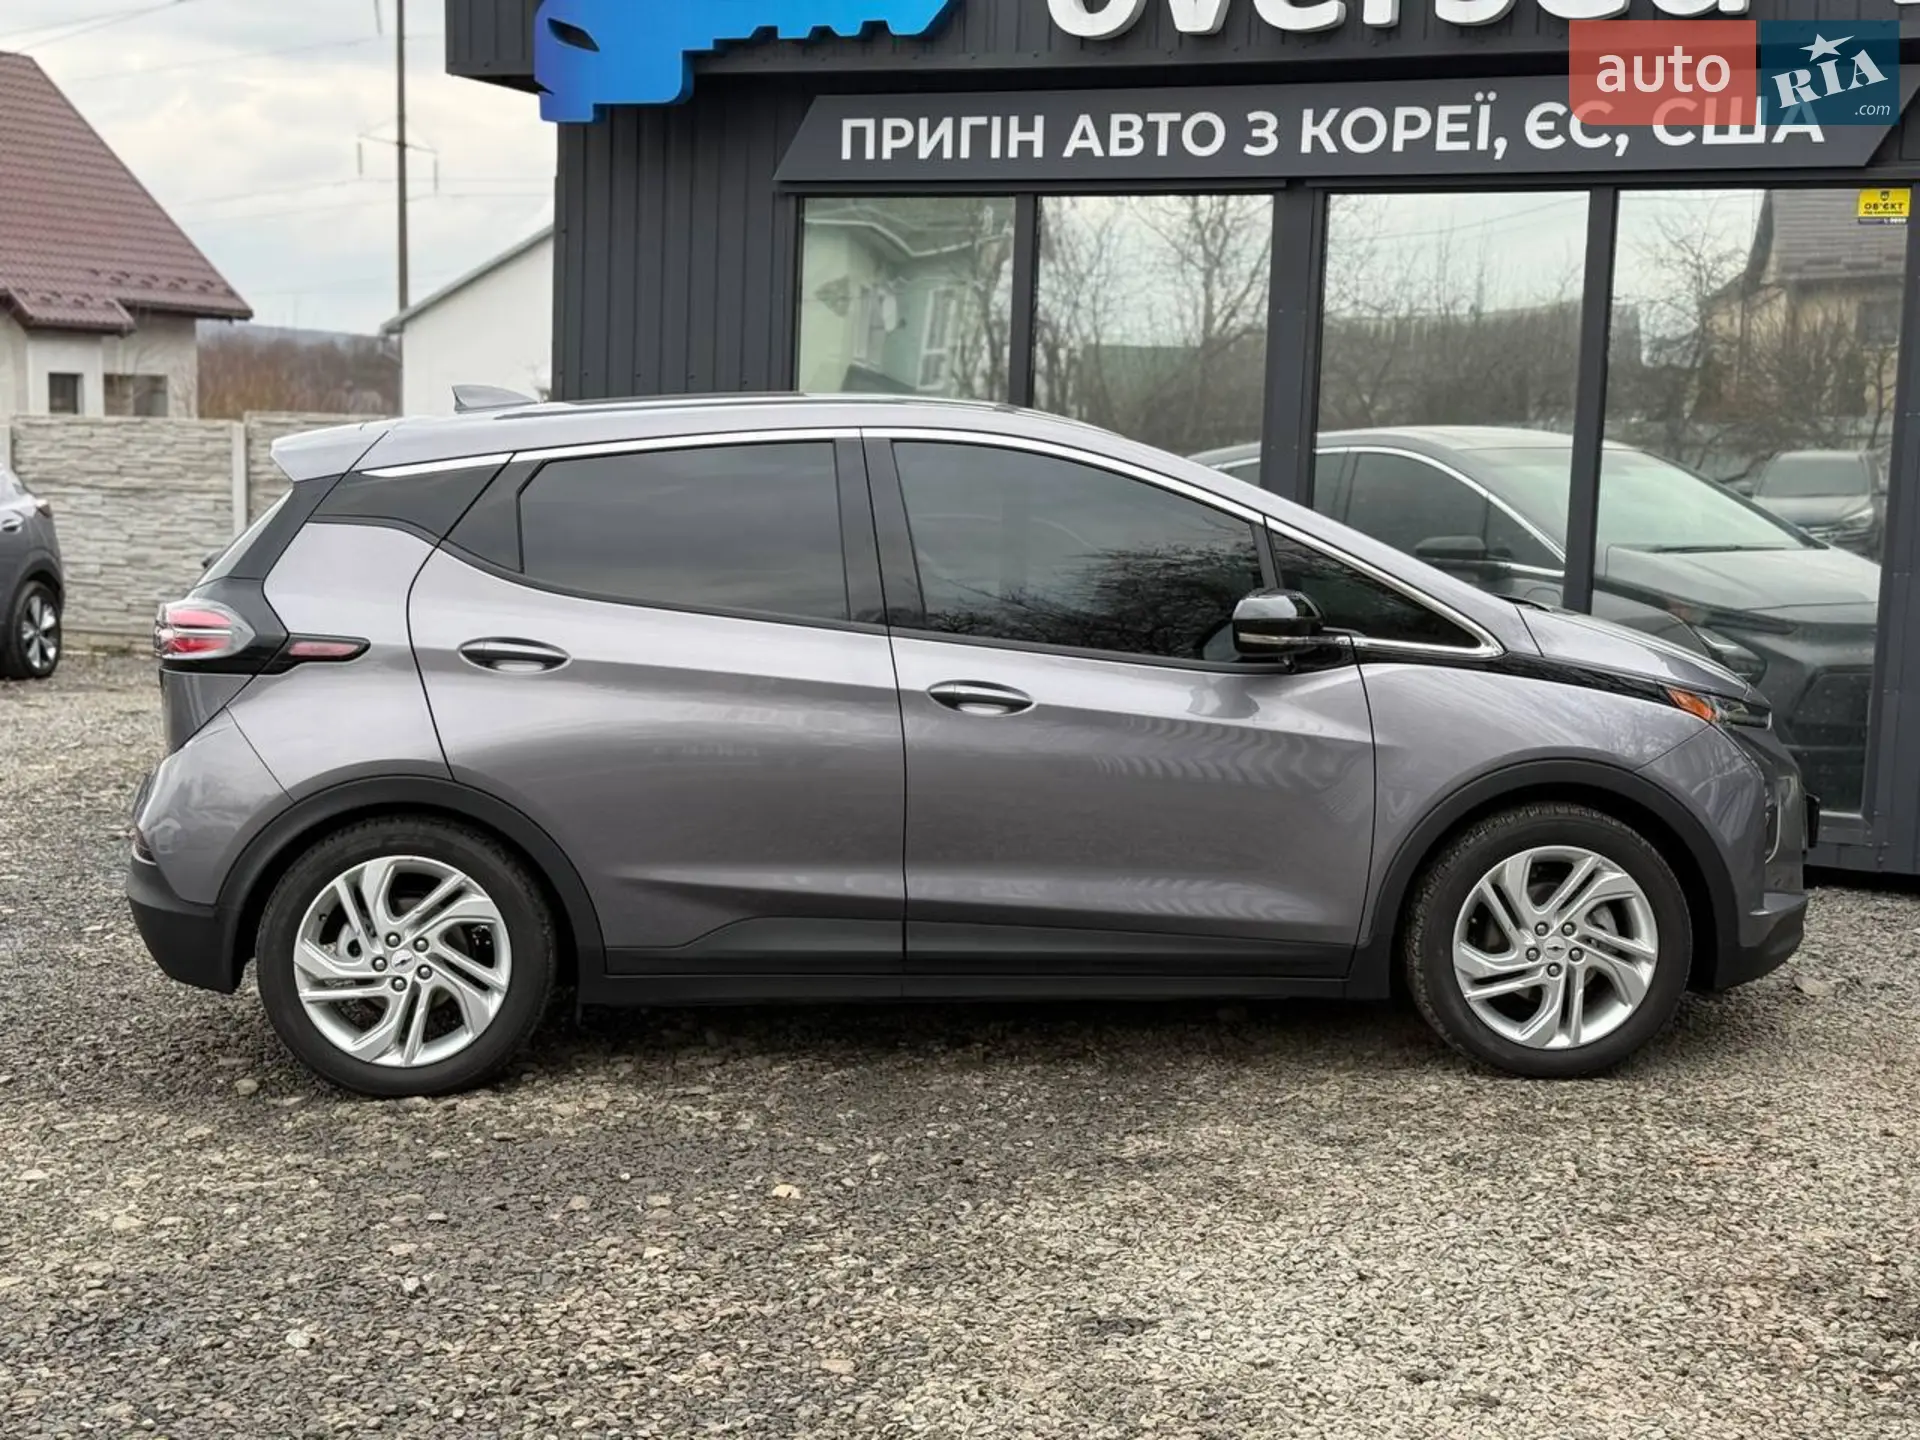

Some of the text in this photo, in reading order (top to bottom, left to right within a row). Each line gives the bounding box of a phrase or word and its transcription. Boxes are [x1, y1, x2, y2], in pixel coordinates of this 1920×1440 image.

[841, 91, 1826, 160] ПРИГІН АВТО З КОРЕЇ, ЄС, США
